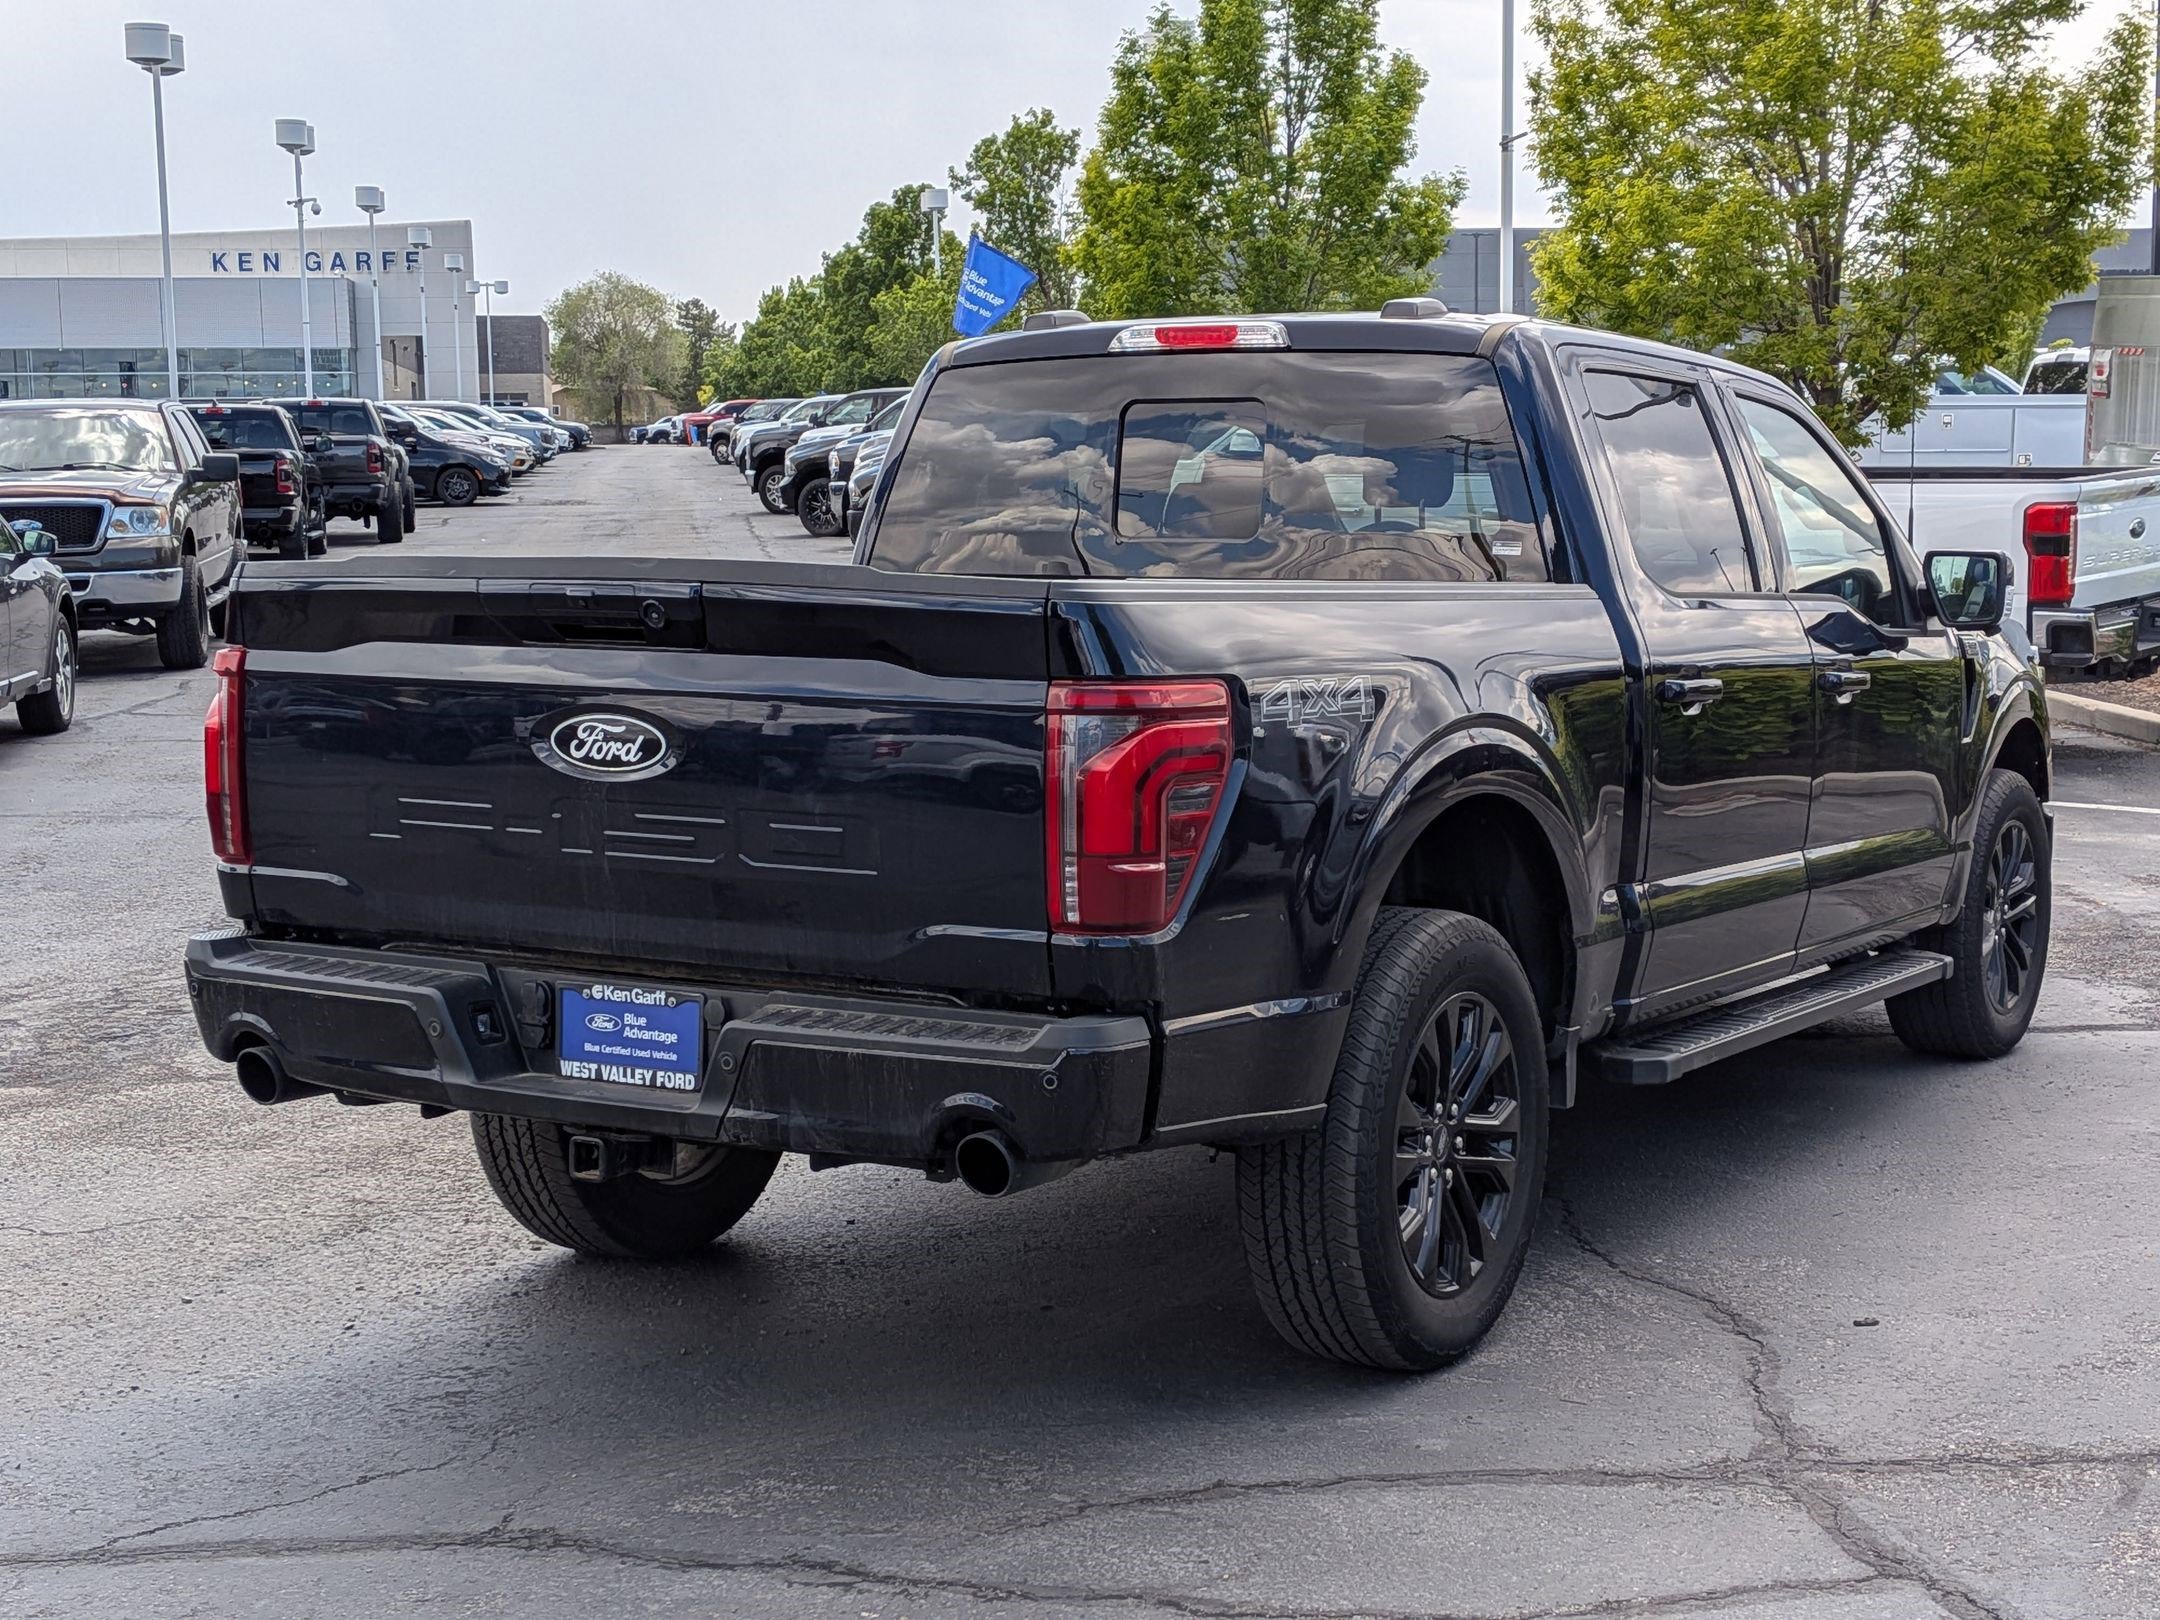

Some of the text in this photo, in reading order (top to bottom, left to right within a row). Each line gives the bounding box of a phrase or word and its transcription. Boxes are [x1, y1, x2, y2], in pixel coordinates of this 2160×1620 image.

[212, 250, 421, 273] KEN GARFF
[968, 269, 988, 287] Blue
[569, 721, 645, 763] Ford
[590, 1013, 647, 1030] Ford Blue
[623, 1026, 678, 1045] Advantage
[584, 1043, 678, 1061] Blue Certified Used Vehicle
[559, 1060, 696, 1090] WEST VALLEY FORD
